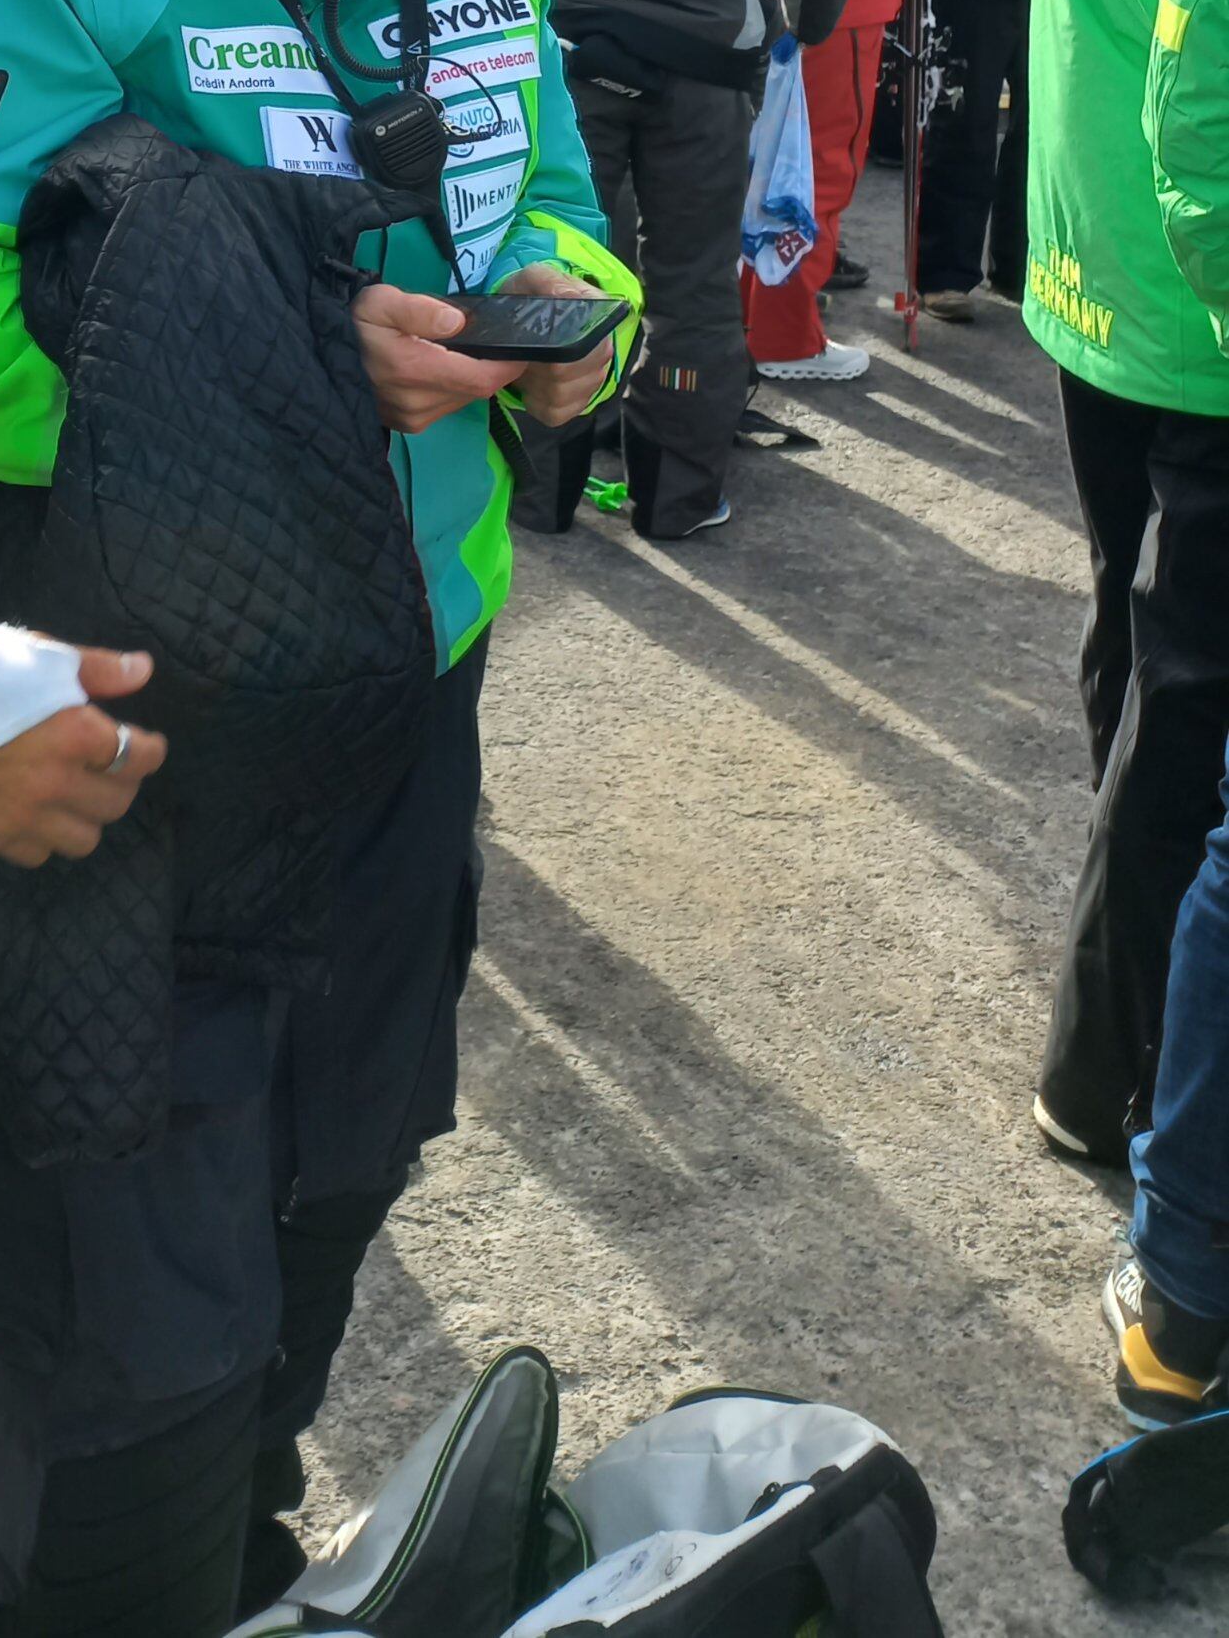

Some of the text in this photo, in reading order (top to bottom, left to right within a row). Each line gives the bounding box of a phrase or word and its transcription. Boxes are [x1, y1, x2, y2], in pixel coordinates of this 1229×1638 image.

[431, 59, 489, 85] andorra
[488, 50, 535, 70] telecom
[195, 76, 275, 89] Crèdit Andorrà
[283, 159, 302, 170] THE
[304, 160, 334, 171] WHITE
